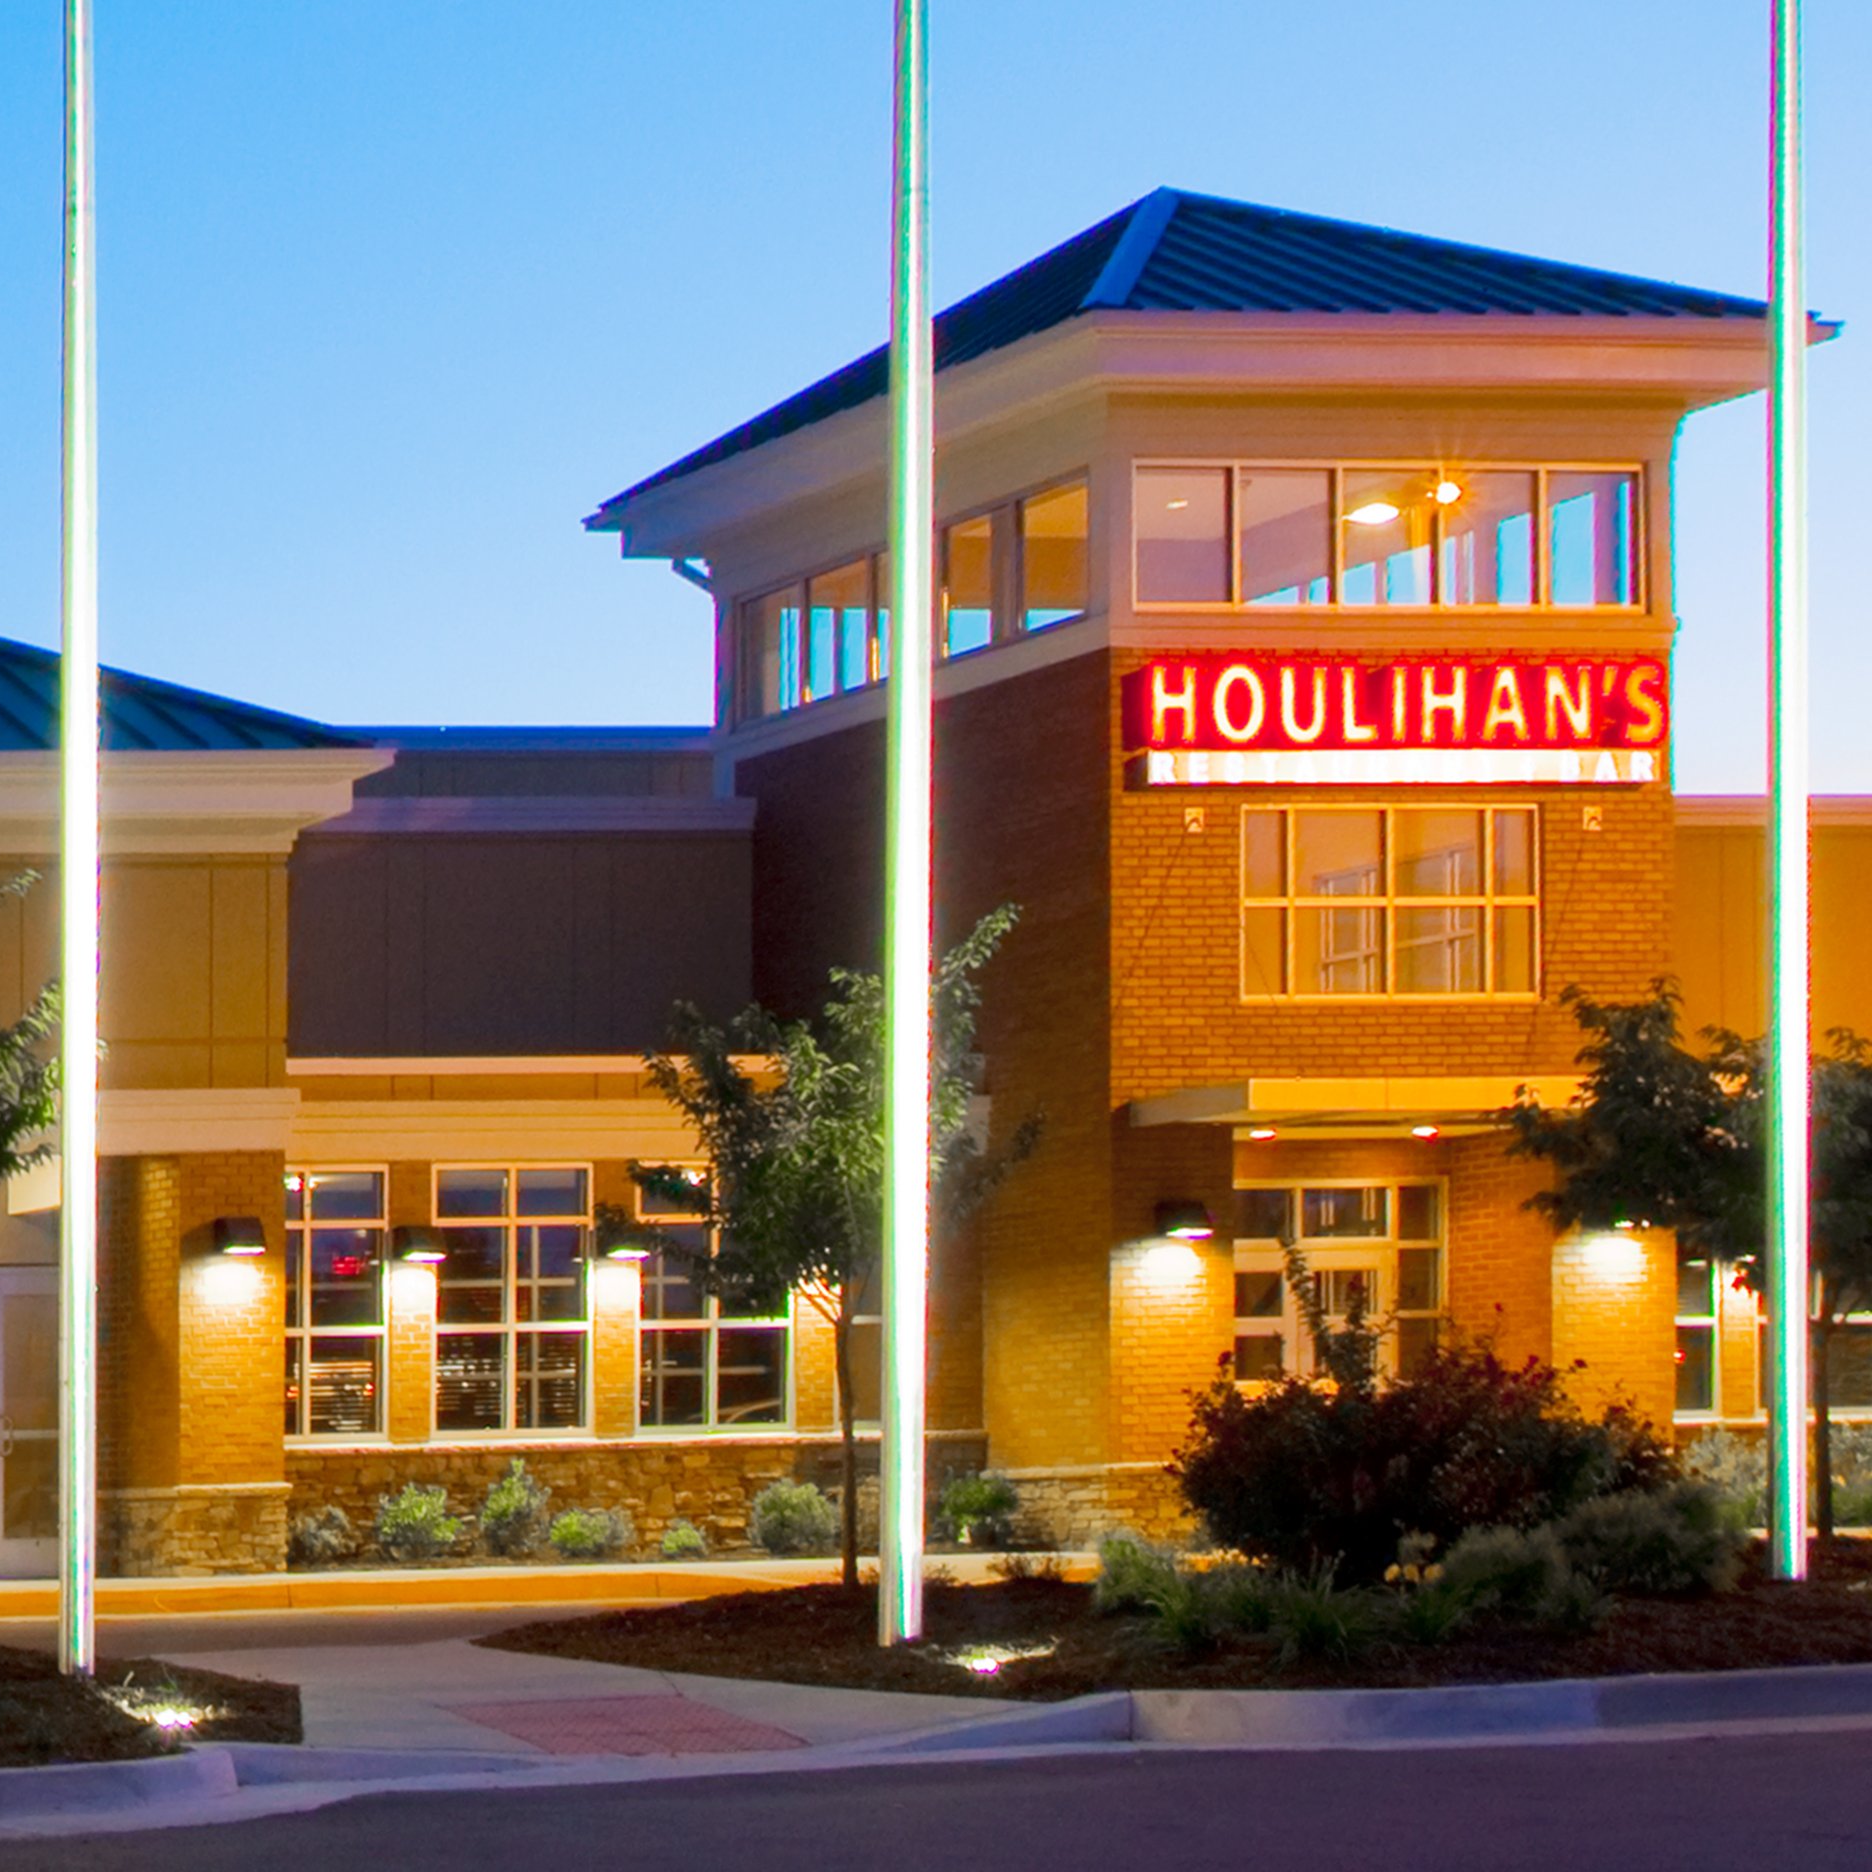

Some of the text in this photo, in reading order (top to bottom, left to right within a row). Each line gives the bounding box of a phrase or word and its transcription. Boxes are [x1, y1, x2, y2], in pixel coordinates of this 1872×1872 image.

[1150, 664, 1666, 743] HOULIHAN'S
[1151, 750, 1497, 783] RESTAU
[1559, 750, 1654, 783] BAR
